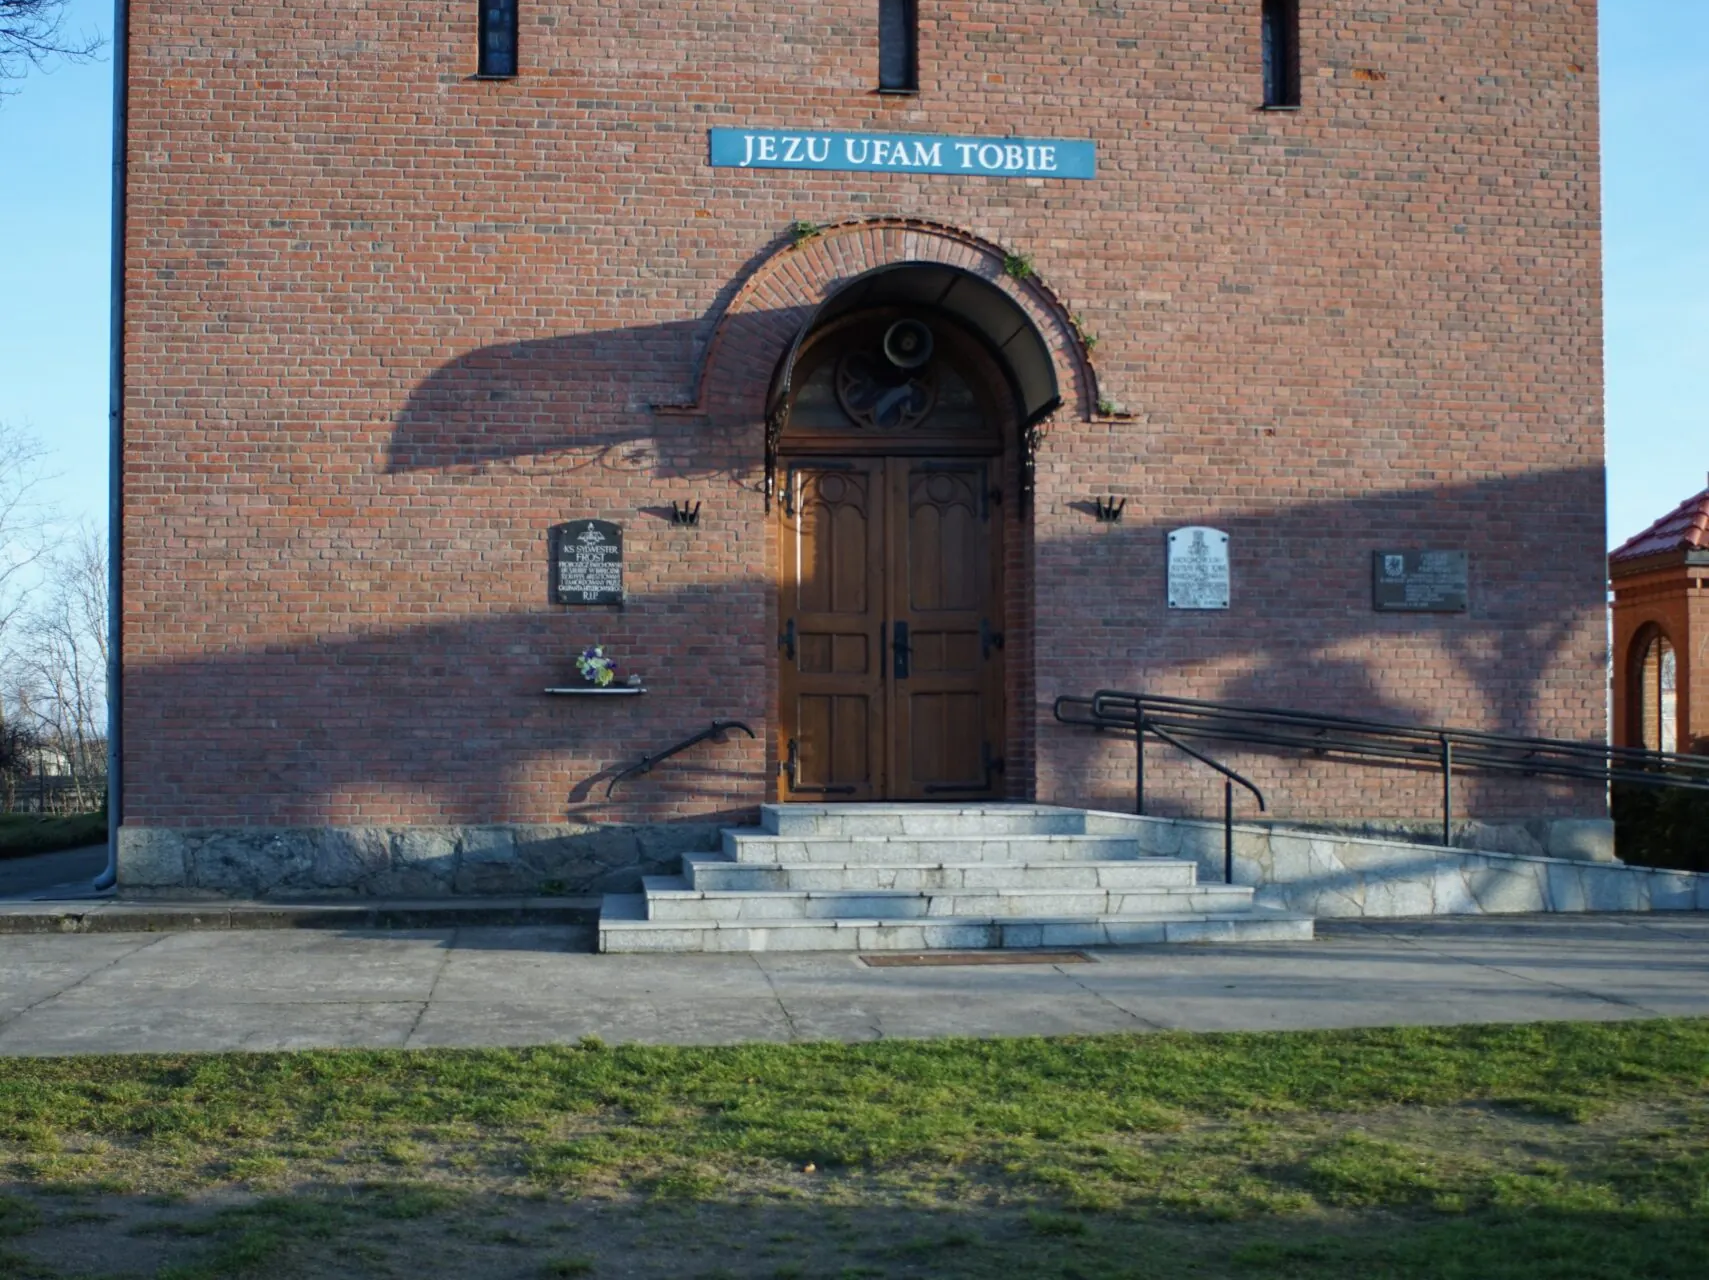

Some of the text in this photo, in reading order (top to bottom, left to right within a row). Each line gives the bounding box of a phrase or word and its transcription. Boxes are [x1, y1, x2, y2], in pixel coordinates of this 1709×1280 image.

[739, 135, 1058, 171] JEZU UFAM TOBIE
[576, 553, 605, 562] FROST
